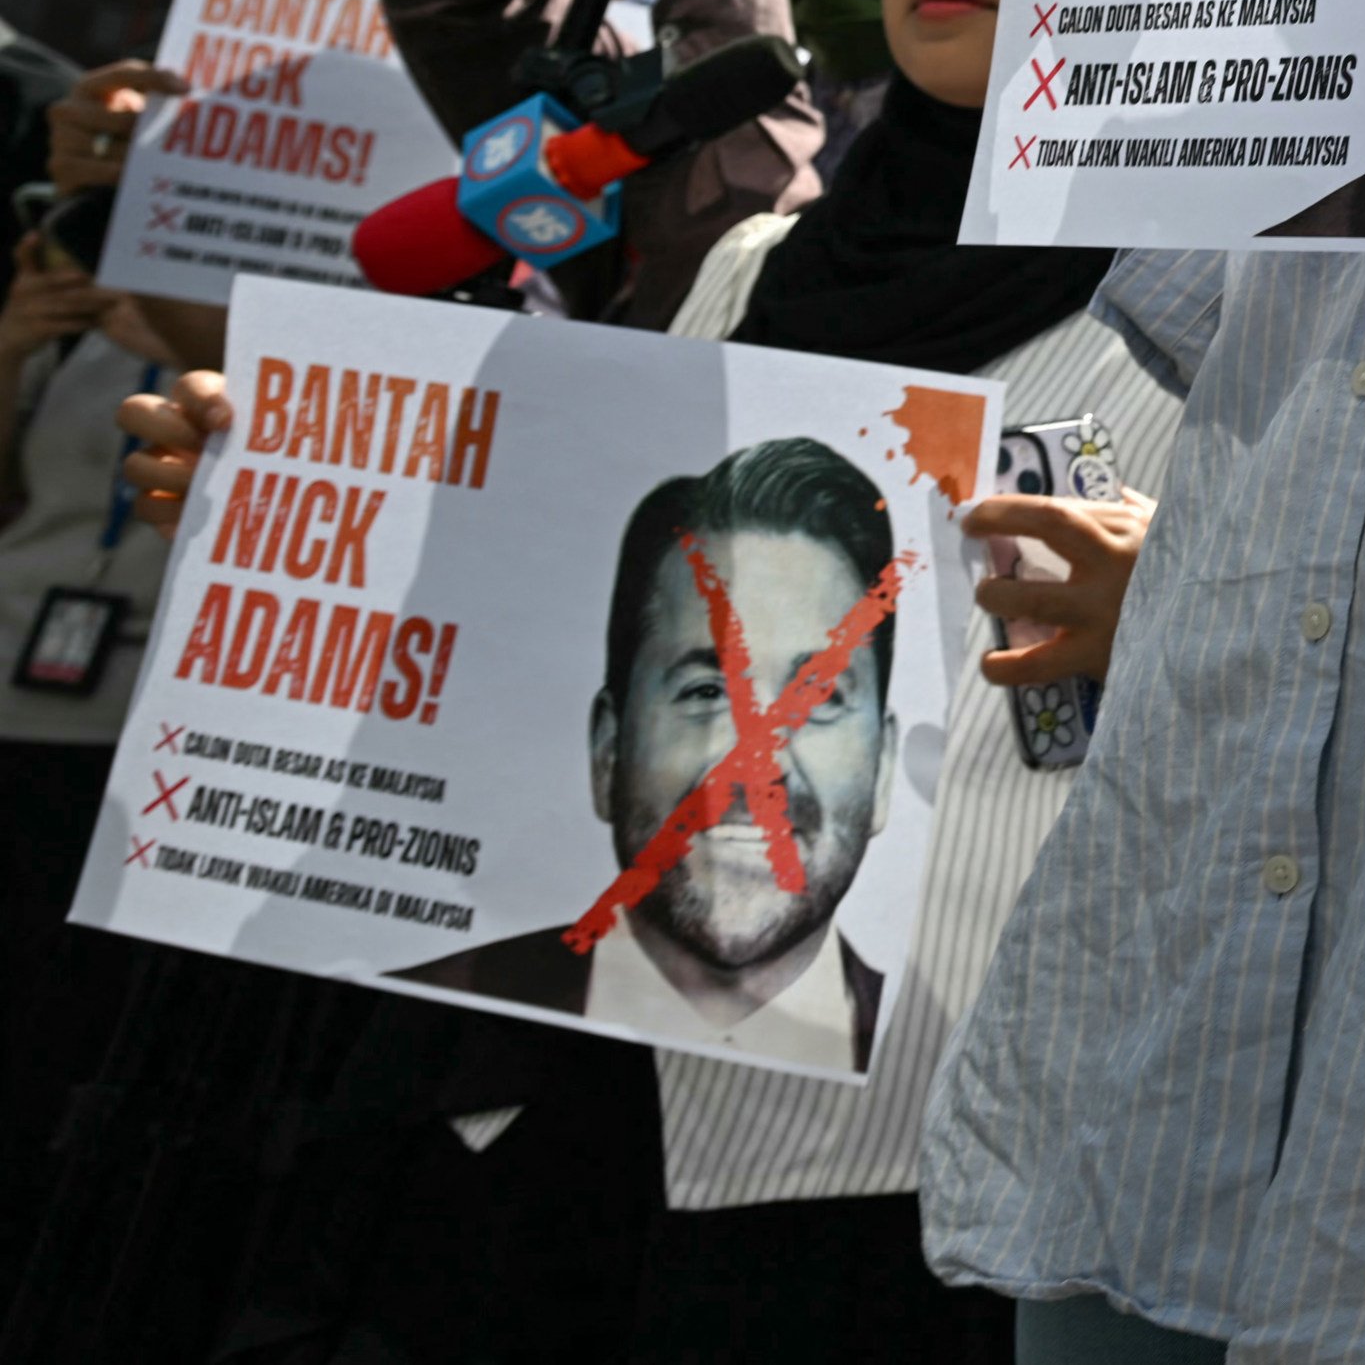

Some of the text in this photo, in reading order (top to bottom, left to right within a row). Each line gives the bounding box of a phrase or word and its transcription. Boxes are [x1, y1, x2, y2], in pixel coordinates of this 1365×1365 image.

[1058, 6, 1103, 35] CALON
[1105, 3, 1142, 32] DUTA
[1144, 1, 1192, 30] BESAR
[1192, 0, 1215, 28] AS
[184, 32, 312, 107] NICK
[1064, 54, 1358, 106] ANTI-ISLAM & PRO-ZIONIS
[162, 99, 377, 187] ADAMS!
[1036, 136, 1350, 167] TIDAK LAYAK WAKILI AMERIKA DI MALAYSIA
[246, 356, 501, 490] BANTAH
[210, 468, 387, 588] NICK
[174, 582, 459, 726] ADAMS!
[184, 731, 447, 803] CALON DUTA BESAR AS KE MALAYSIA
[186, 785, 482, 876] ANTI-ISLAM & PRO-ZIONIS
[154, 845, 200, 874] TIDAK
[197, 854, 246, 886] LAYAK
[299, 876, 373, 913] AMERIKA
[373, 890, 393, 916] DI
[391, 894, 476, 933] MALAYSIA
